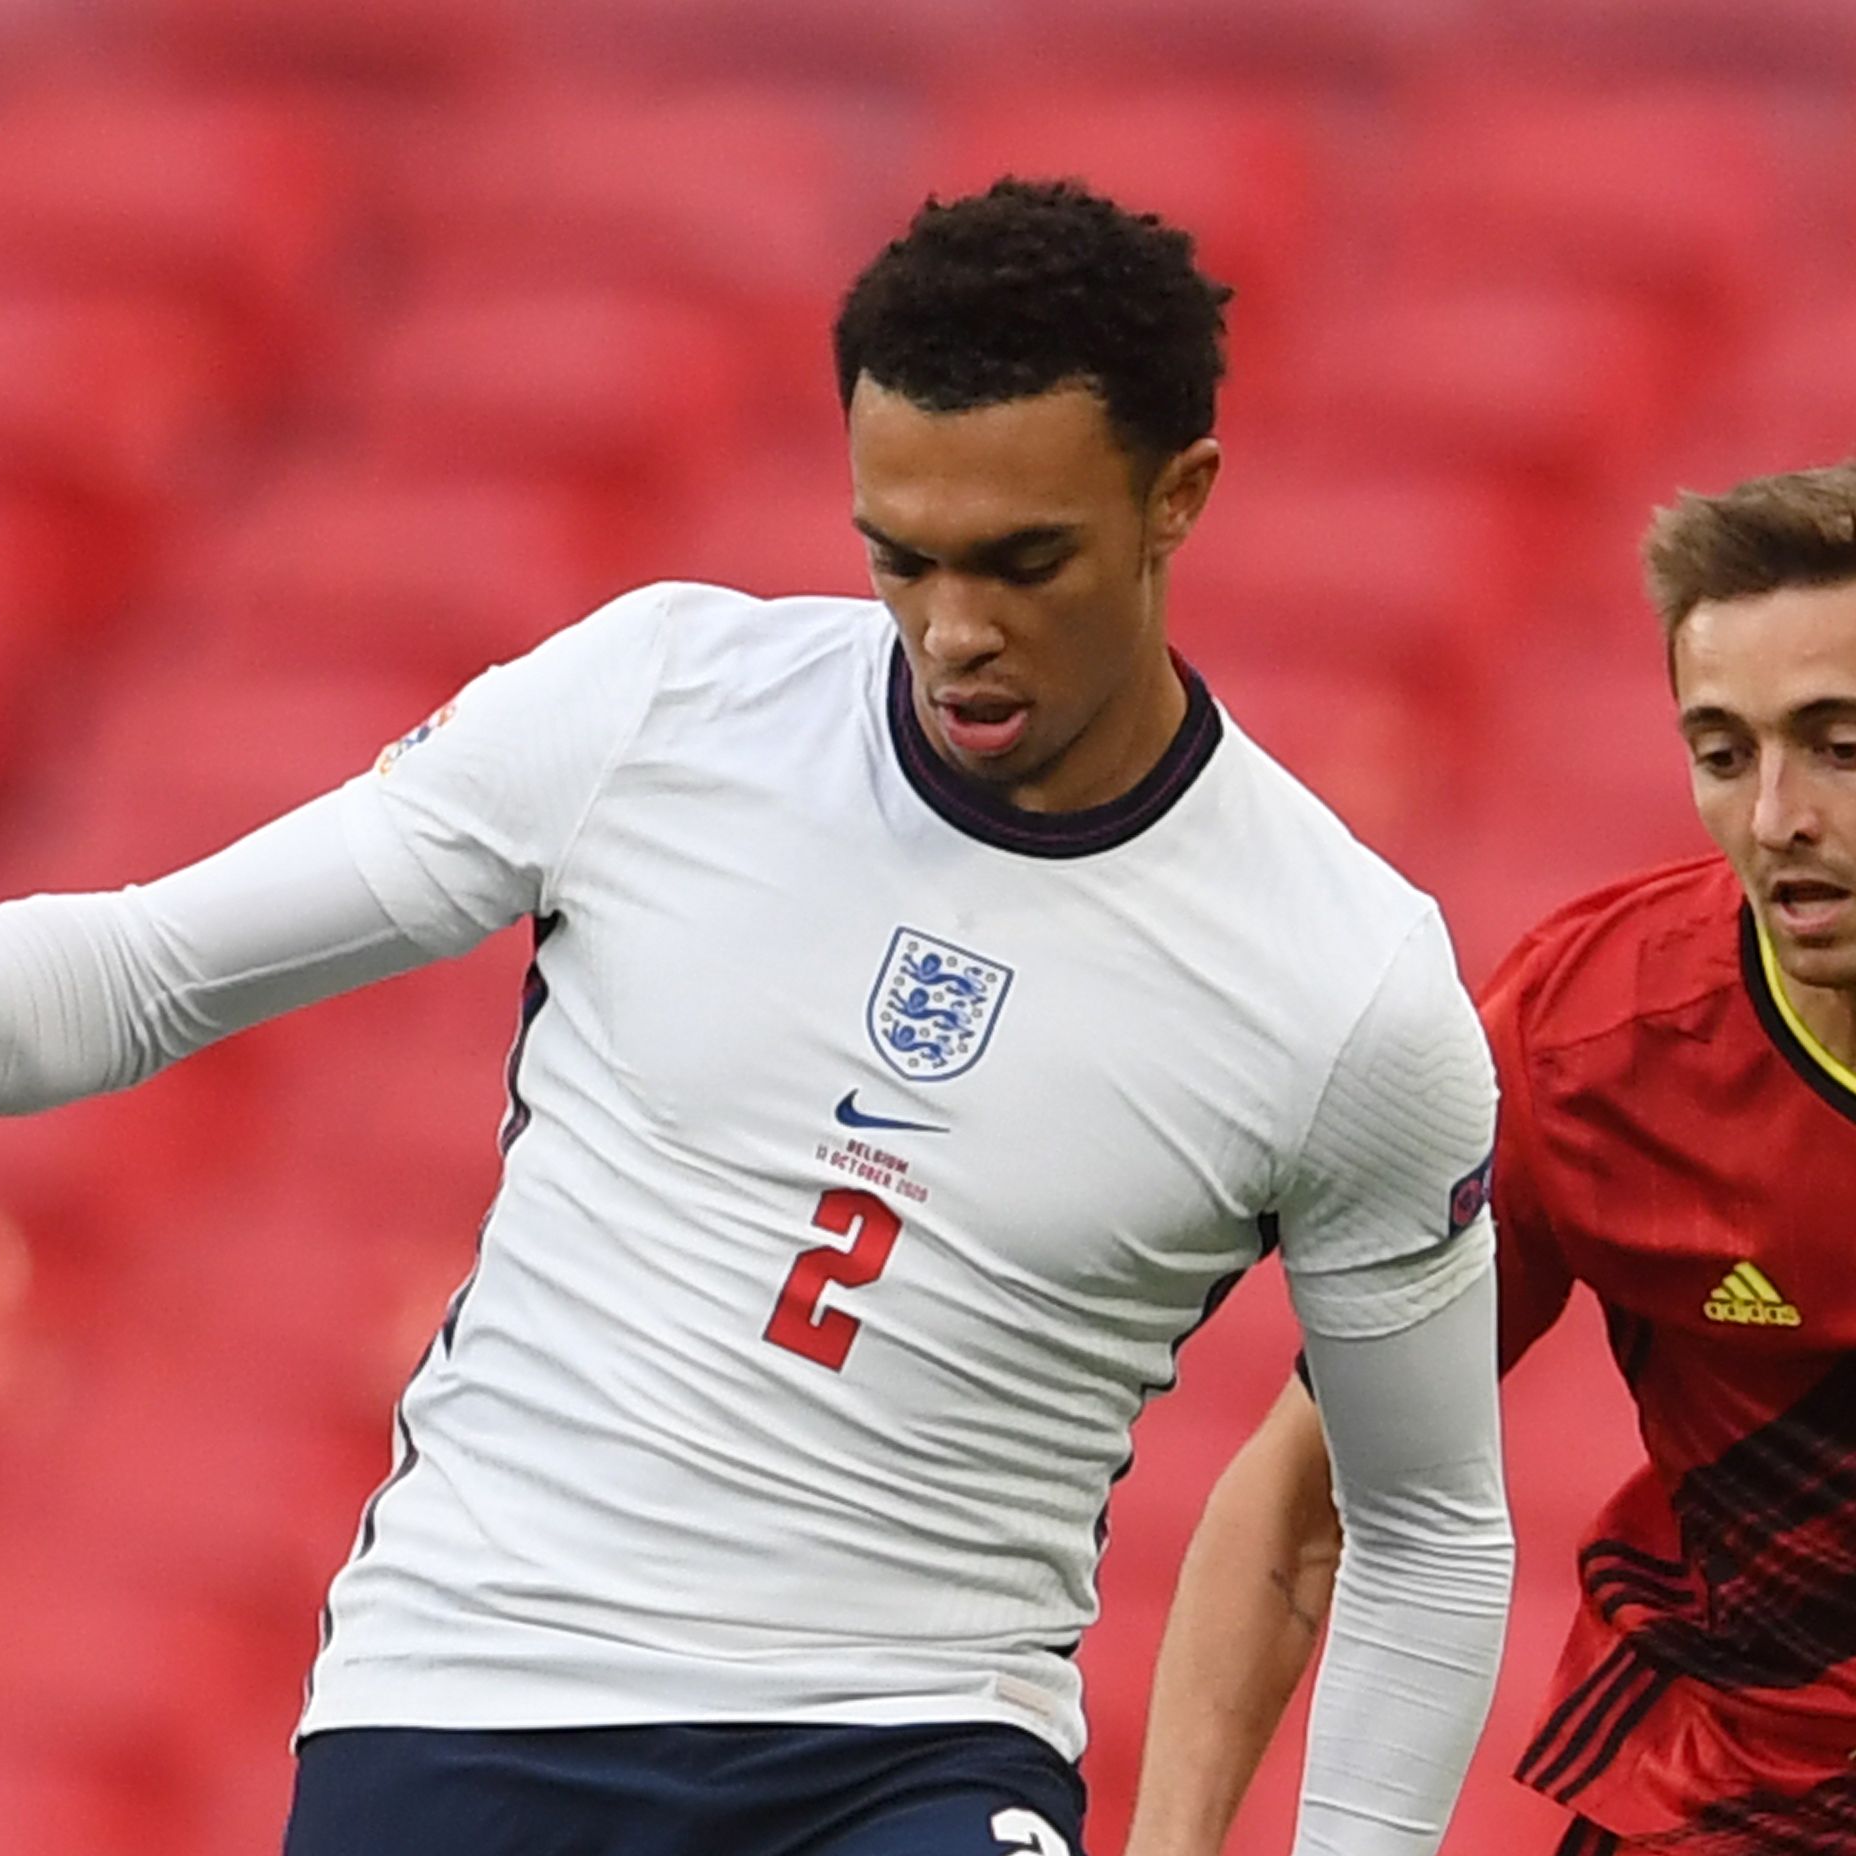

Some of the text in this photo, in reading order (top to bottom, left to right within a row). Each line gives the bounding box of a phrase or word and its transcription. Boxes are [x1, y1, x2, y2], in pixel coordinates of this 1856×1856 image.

[830, 1150, 892, 1188] OCTOBER
[846, 1138, 909, 1174] BELGIUM
[762, 1186, 903, 1373] 2
[1703, 1299, 1802, 1327] adidas
